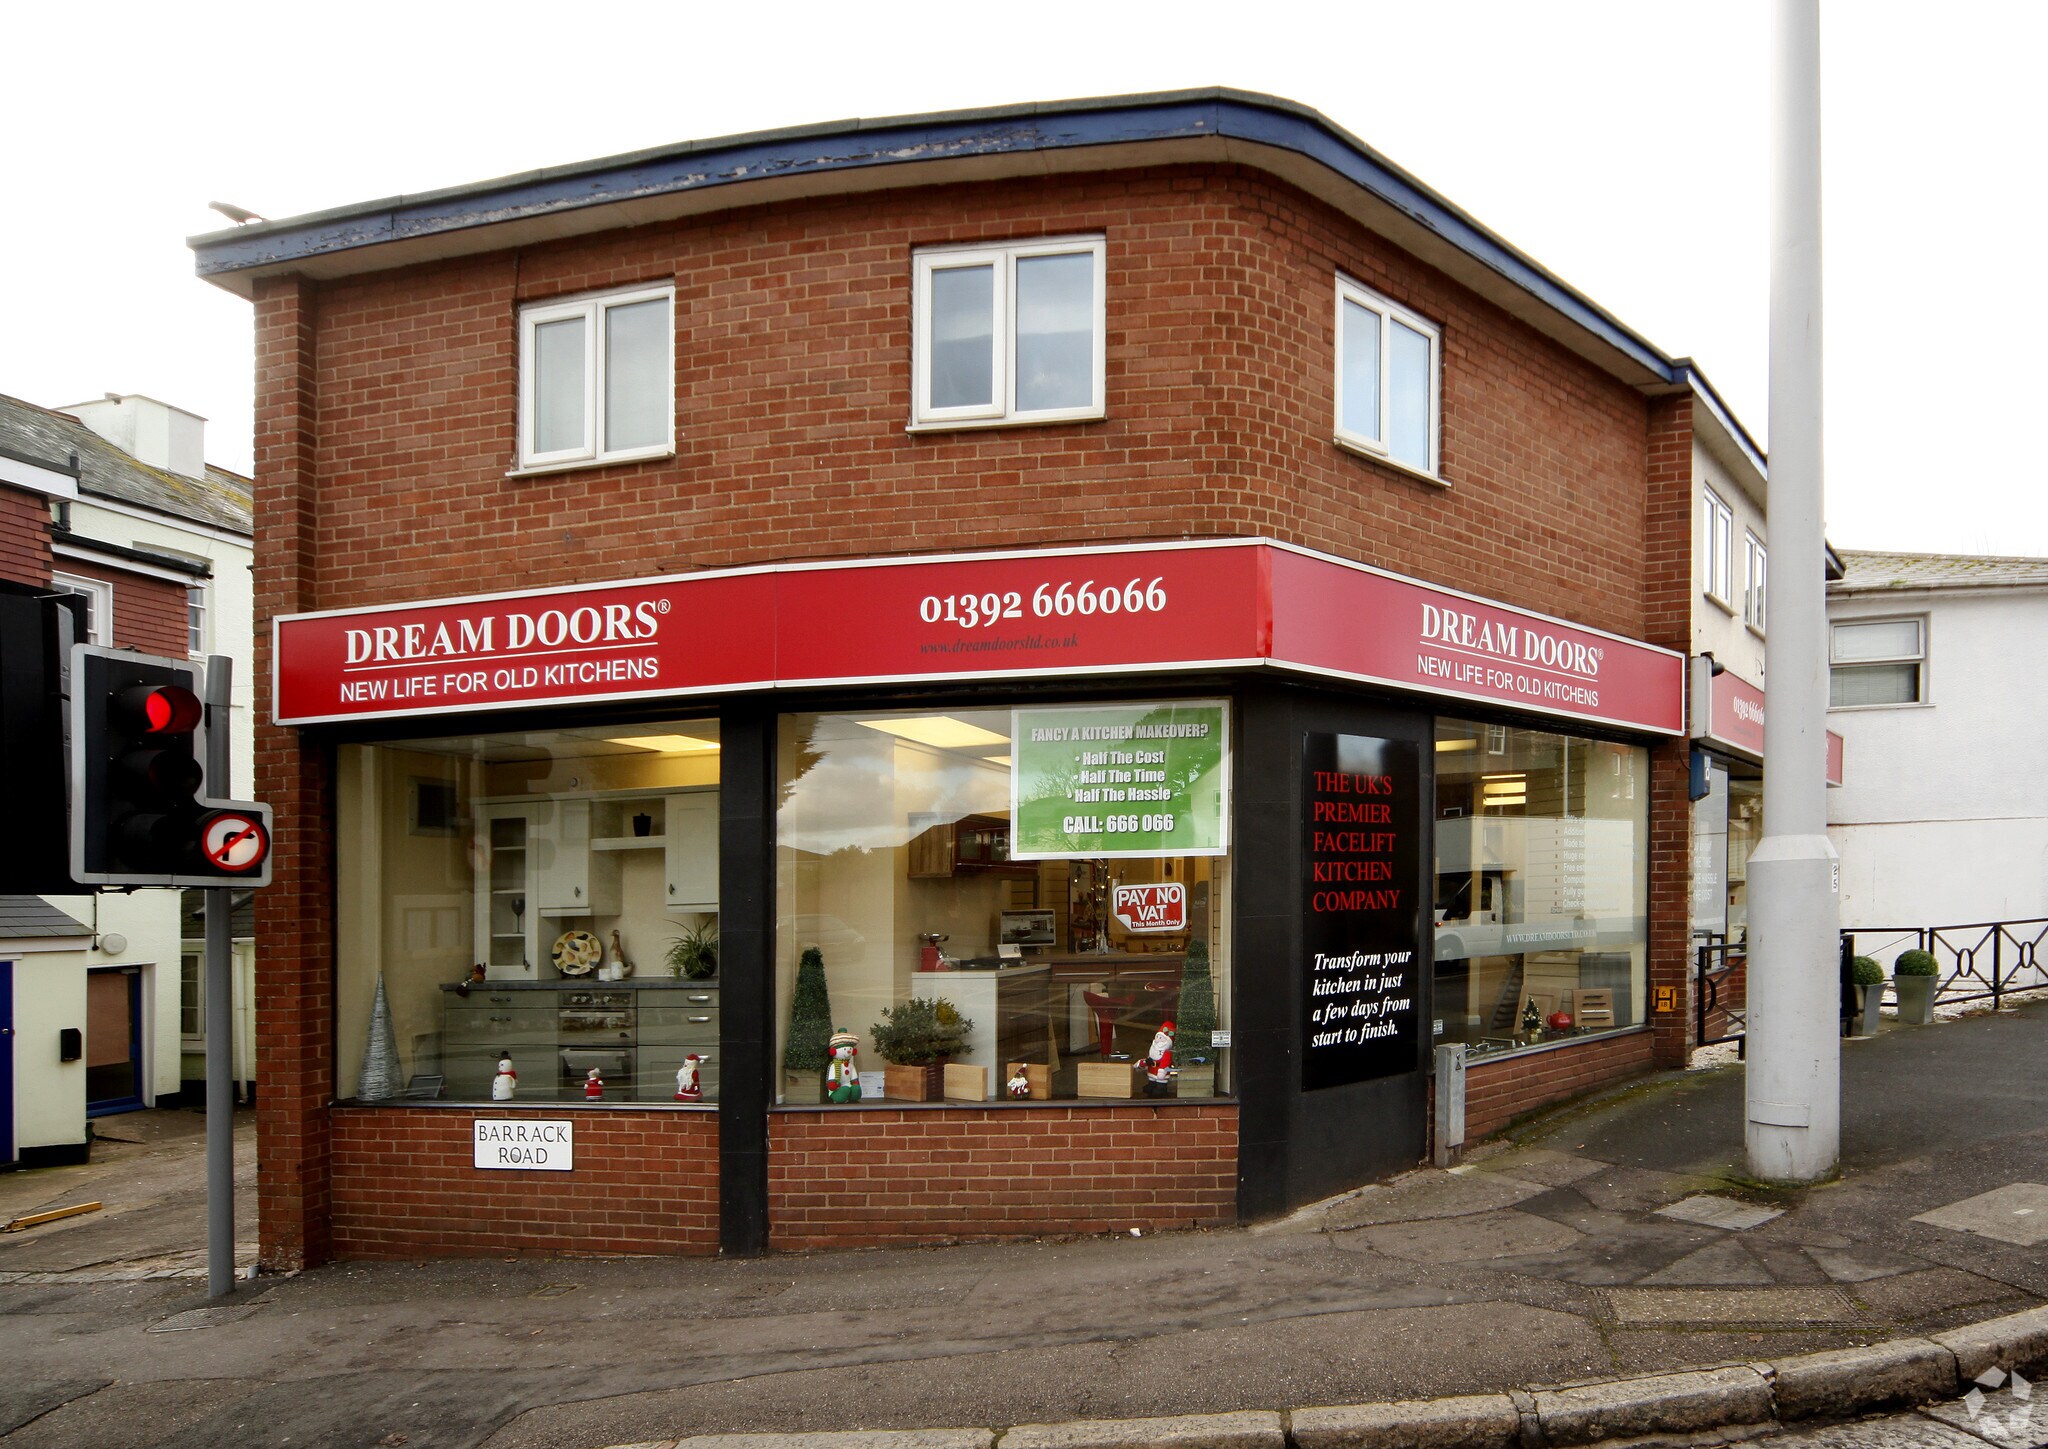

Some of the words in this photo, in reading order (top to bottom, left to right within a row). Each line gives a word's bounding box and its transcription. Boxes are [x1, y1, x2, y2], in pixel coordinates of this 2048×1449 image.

[920, 591, 1023, 628] 01392
[1032, 576, 1167, 617] 666066
[344, 616, 496, 664] DREAM
[1420, 603, 1518, 658] DREAM
[920, 633, 1079, 654] www.dreamdoorsltd.co.uk
[341, 679, 388, 702] NEW
[393, 676, 437, 698] LIFE
[443, 671, 488, 694] FOR
[494, 667, 538, 690] OLD
[544, 657, 658, 685] KITCHENS
[1417, 654, 1452, 679] NEW
[1455, 662, 1483, 685] LIFE
[1487, 669, 1514, 691] FOR
[1516, 675, 1541, 695] OLD
[1544, 681, 1599, 707] KITCHENS
[1031, 727, 1070, 742] FANCY
[1071, 728, 1080, 741] A
[1081, 726, 1134, 740] KITCHEN
[1136, 724, 1209, 739] MAKEOVER?
[1082, 751, 1109, 766] Half
[1111, 751, 1133, 765] The
[1136, 750, 1165, 764] Cost
[1080, 770, 1108, 784] Half
[1109, 769, 1132, 783] The
[1134, 768, 1165, 783] Time
[1313, 771, 1350, 792] THE
[1355, 774, 1393, 795] UK'S
[1074, 788, 1101, 803] Half
[1102, 788, 1126, 802] The
[1127, 787, 1171, 802] Hassle
[1313, 801, 1392, 824] PREMIER
[1063, 815, 1104, 834] CALL:
[1106, 814, 1139, 833] 666
[1142, 814, 1174, 832] 066
[1313, 831, 1396, 852] FACELIFT
[1313, 861, 1392, 882] KITCHEN
[1118, 888, 1150, 907] PAY
[1156, 886, 1181, 904] NO
[1312, 889, 1400, 913] COMPANY
[1136, 905, 1167, 921] VAT
[1314, 950, 1381, 972] Transform
[1382, 951, 1412, 969] your
[1312, 977, 1361, 996] kitchen
[1364, 974, 1377, 991] in
[1377, 973, 1403, 994] just
[1312, 1009, 1321, 1022] a
[1321, 1003, 1348, 1026] few
[1351, 1000, 1379, 1020] days
[1379, 996, 1410, 1018] from
[1312, 1028, 1343, 1048] start
[1345, 1027, 1357, 1043] to
[1358, 1019, 1398, 1045] finish.
[478, 1125, 568, 1143] BARRACK
[498, 1147, 548, 1164] ROAD
